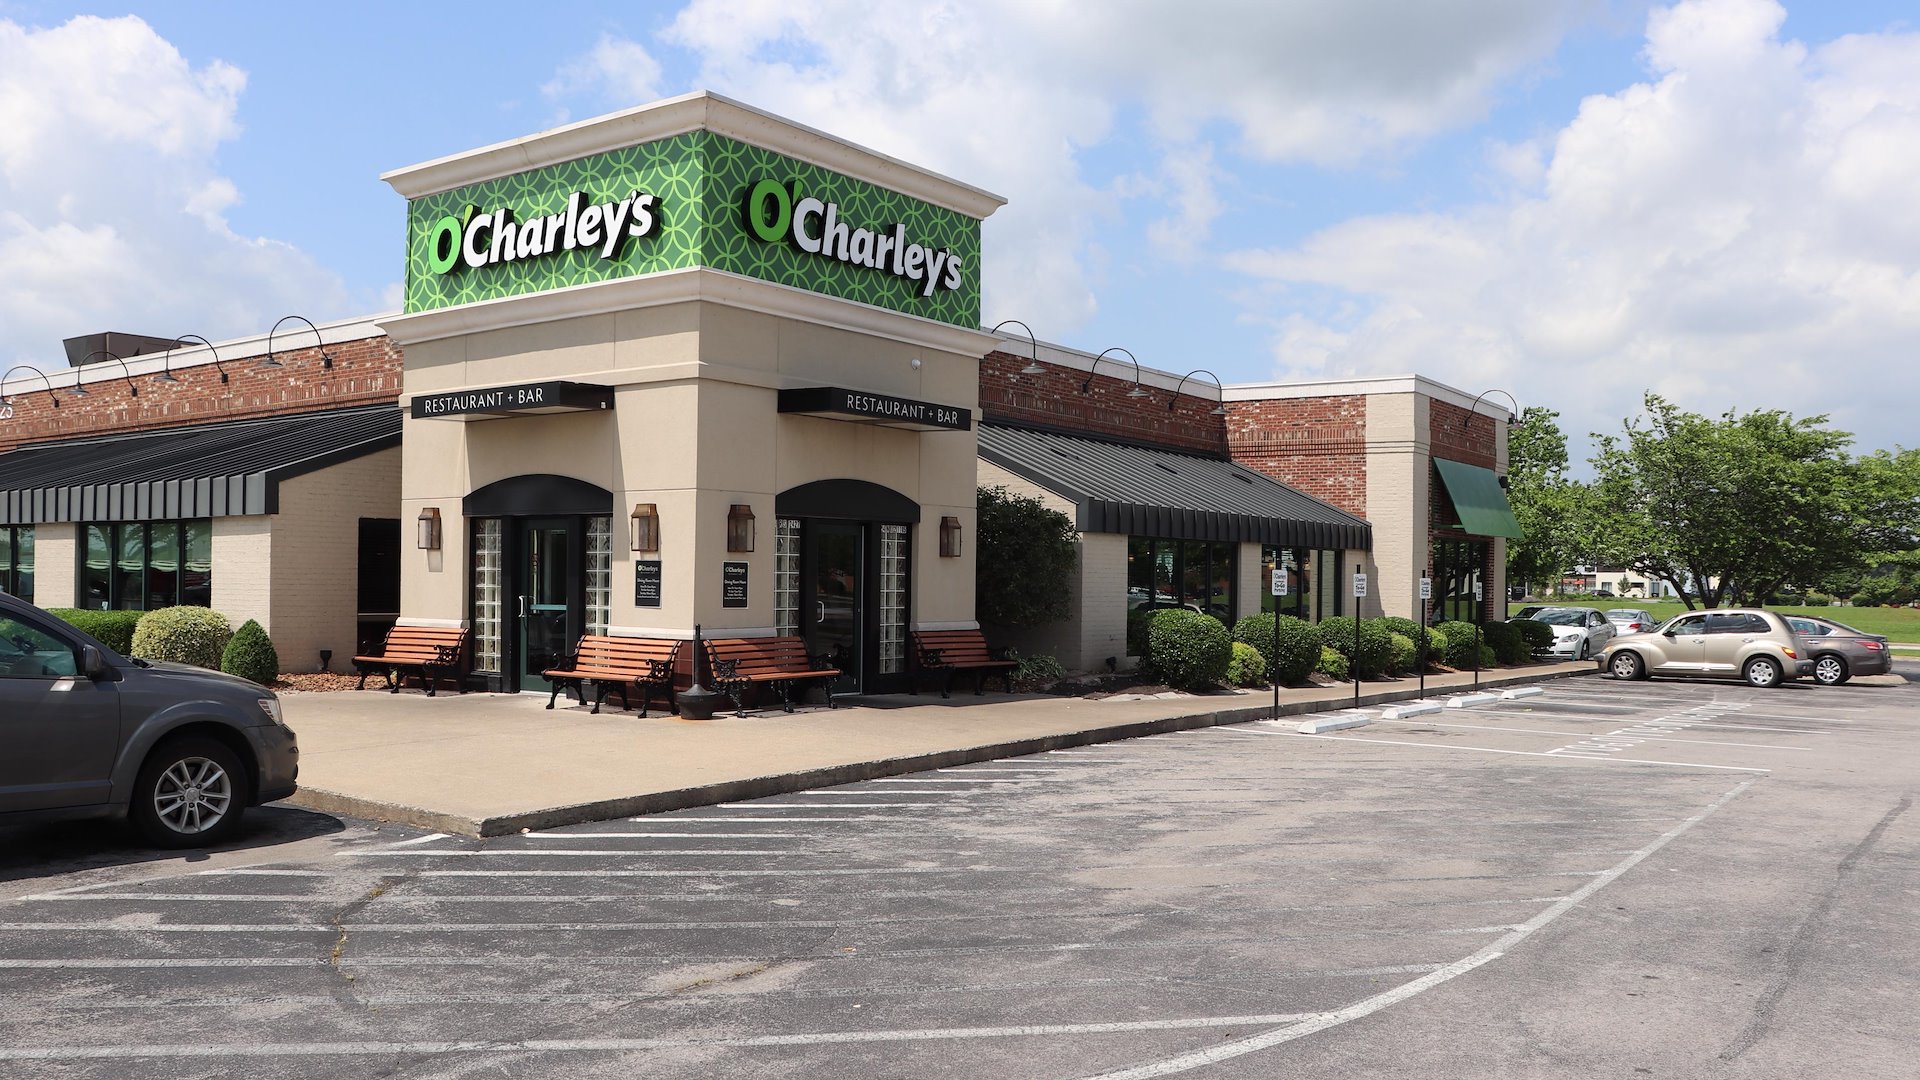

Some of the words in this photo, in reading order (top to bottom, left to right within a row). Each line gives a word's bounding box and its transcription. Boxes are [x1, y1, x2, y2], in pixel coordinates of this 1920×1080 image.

[428, 190, 656, 275] O'Charley's
[748, 178, 962, 297] O'Charley's
[424, 391, 504, 413] RESTAURANT
[518, 387, 544, 404] BAR
[847, 394, 925, 419] RESTAURANT
[937, 409, 958, 424] BAR
